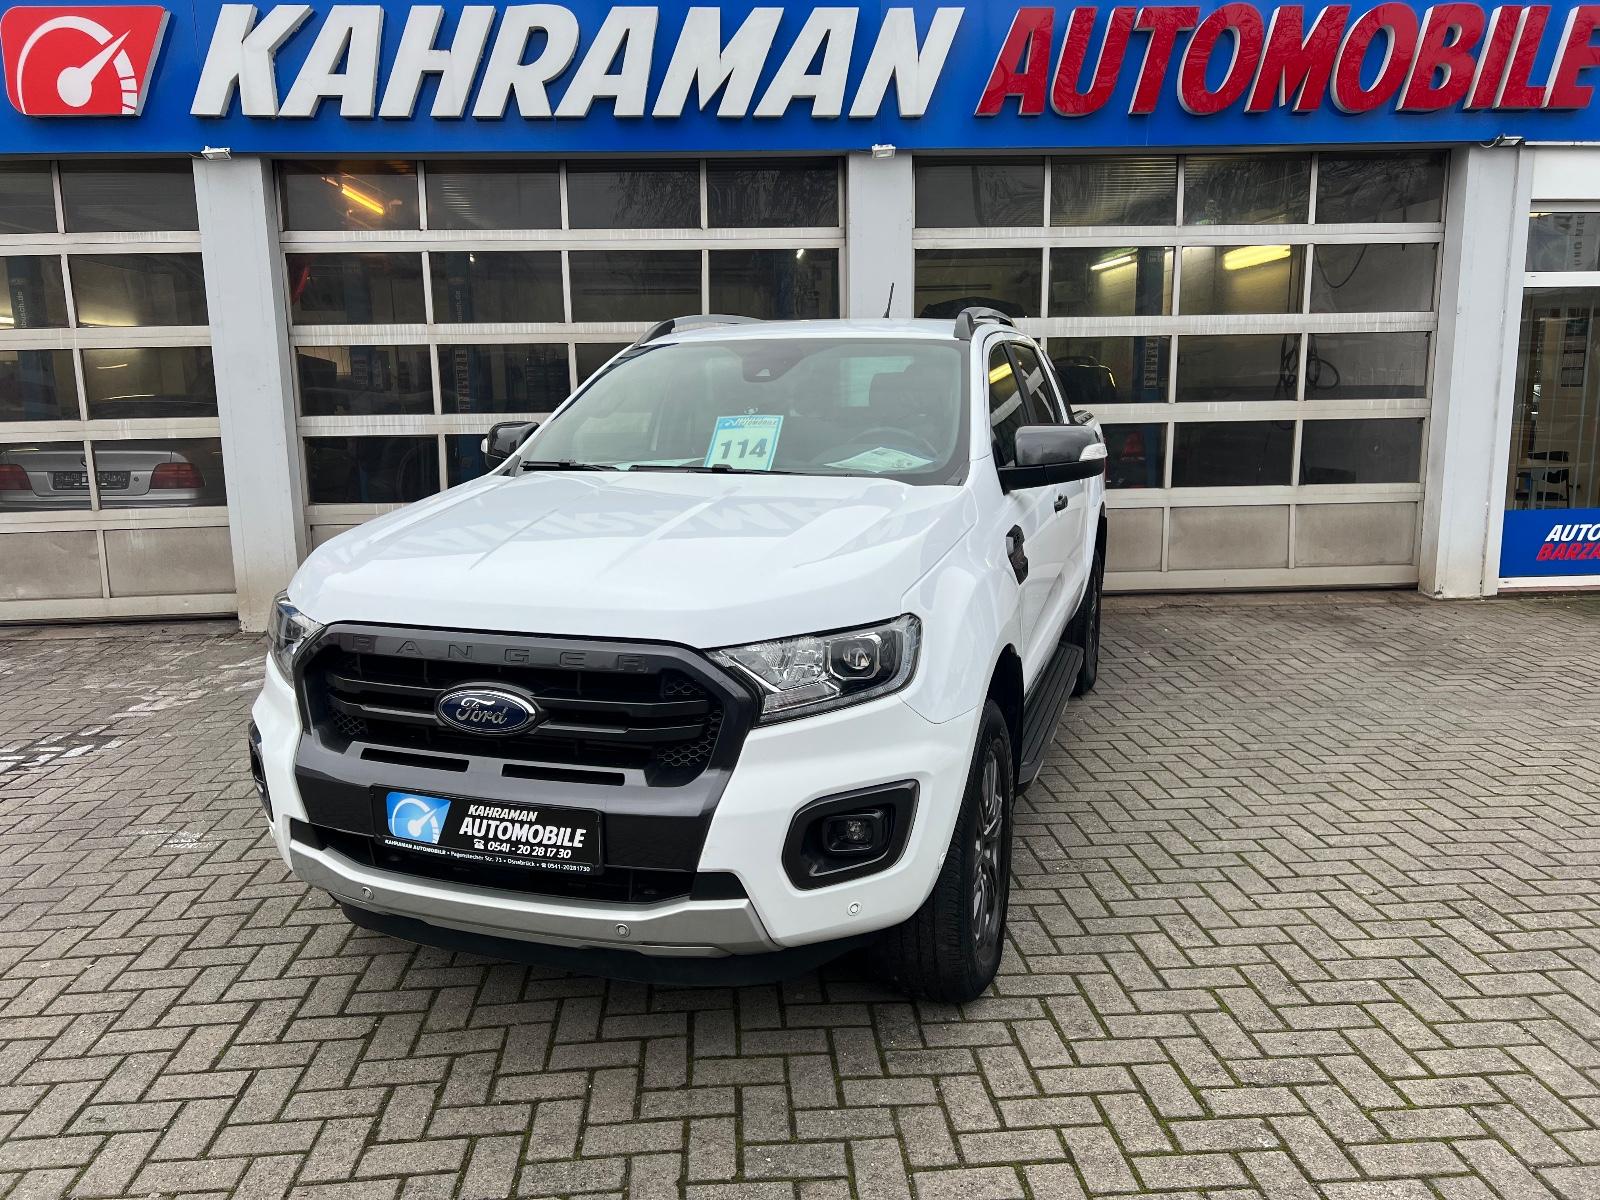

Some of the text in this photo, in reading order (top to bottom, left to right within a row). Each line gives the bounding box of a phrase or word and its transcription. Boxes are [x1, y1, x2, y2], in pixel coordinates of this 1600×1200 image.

[190, 3, 1600, 119] KAHRAMAN AUTOMOBILE
[721, 439, 768, 459] 114
[1545, 524, 1600, 541] AUTO
[352, 636, 648, 672] RANGER
[456, 696, 507, 725] Ford
[468, 805, 538, 822] KAHRAMAN
[459, 817, 587, 848] AUTOMOBILE
[384, 839, 413, 849] KAHRAMAN
[412, 844, 446, 855] AUTOMOBILE
[507, 858, 536, 868] Osnabrück
[487, 841, 511, 853] 0541
[516, 844, 531, 855] 20
[531, 846, 545, 857] 28
[547, 848, 557, 857] 17
[556, 849, 572, 859] 30
